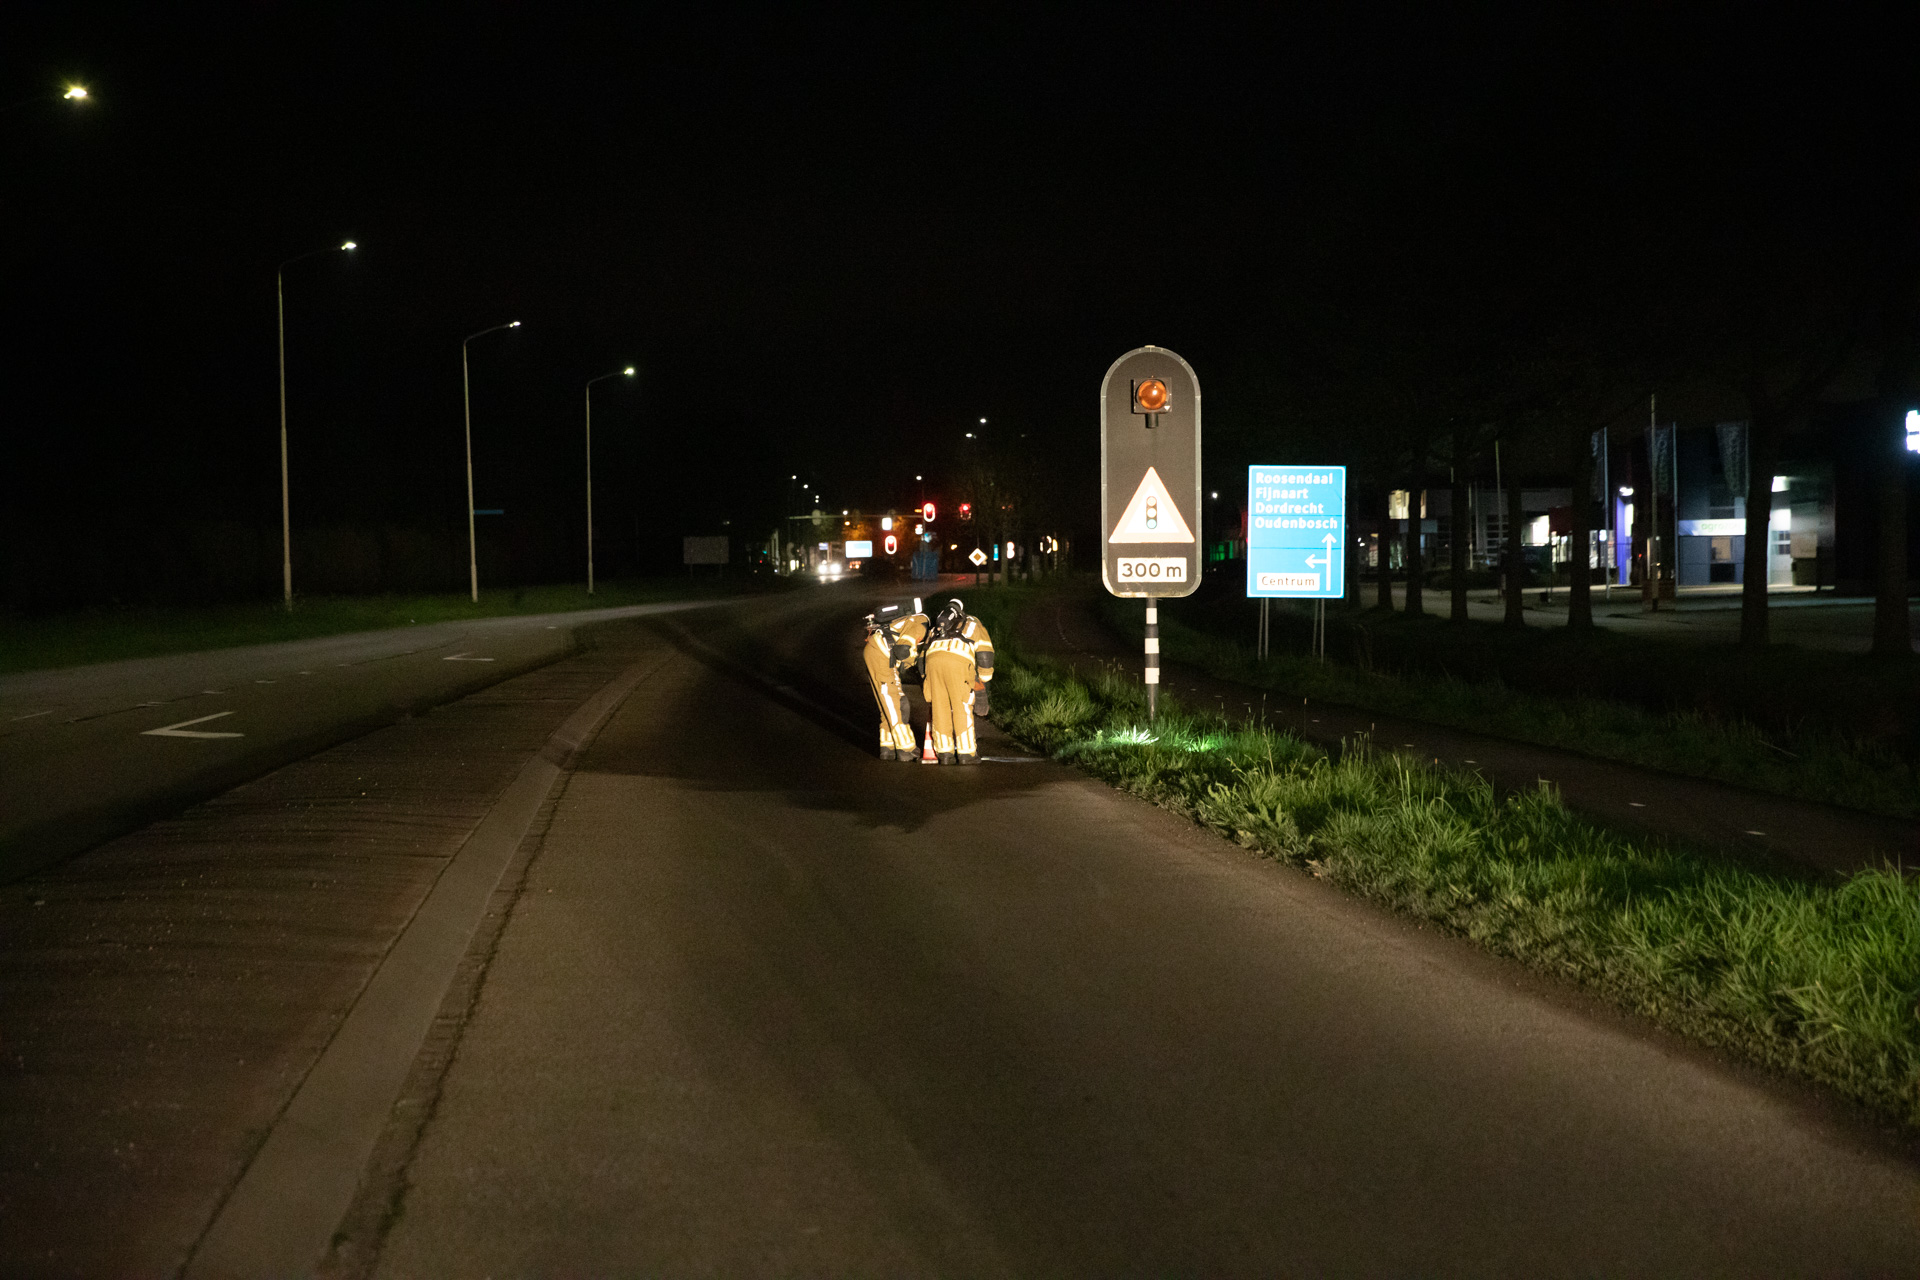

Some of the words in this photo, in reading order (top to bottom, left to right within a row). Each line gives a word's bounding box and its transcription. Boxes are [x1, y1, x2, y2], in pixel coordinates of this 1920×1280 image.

[1256, 472, 1333, 484] Roosendaal
[1255, 487, 1309, 501] Fijnaart
[1255, 502, 1324, 514] Dordrecht
[1255, 517, 1338, 529] Oudenbosch
[1121, 562, 1161, 577] 300
[1166, 566, 1182, 577] m
[1261, 576, 1315, 586] Centrum
